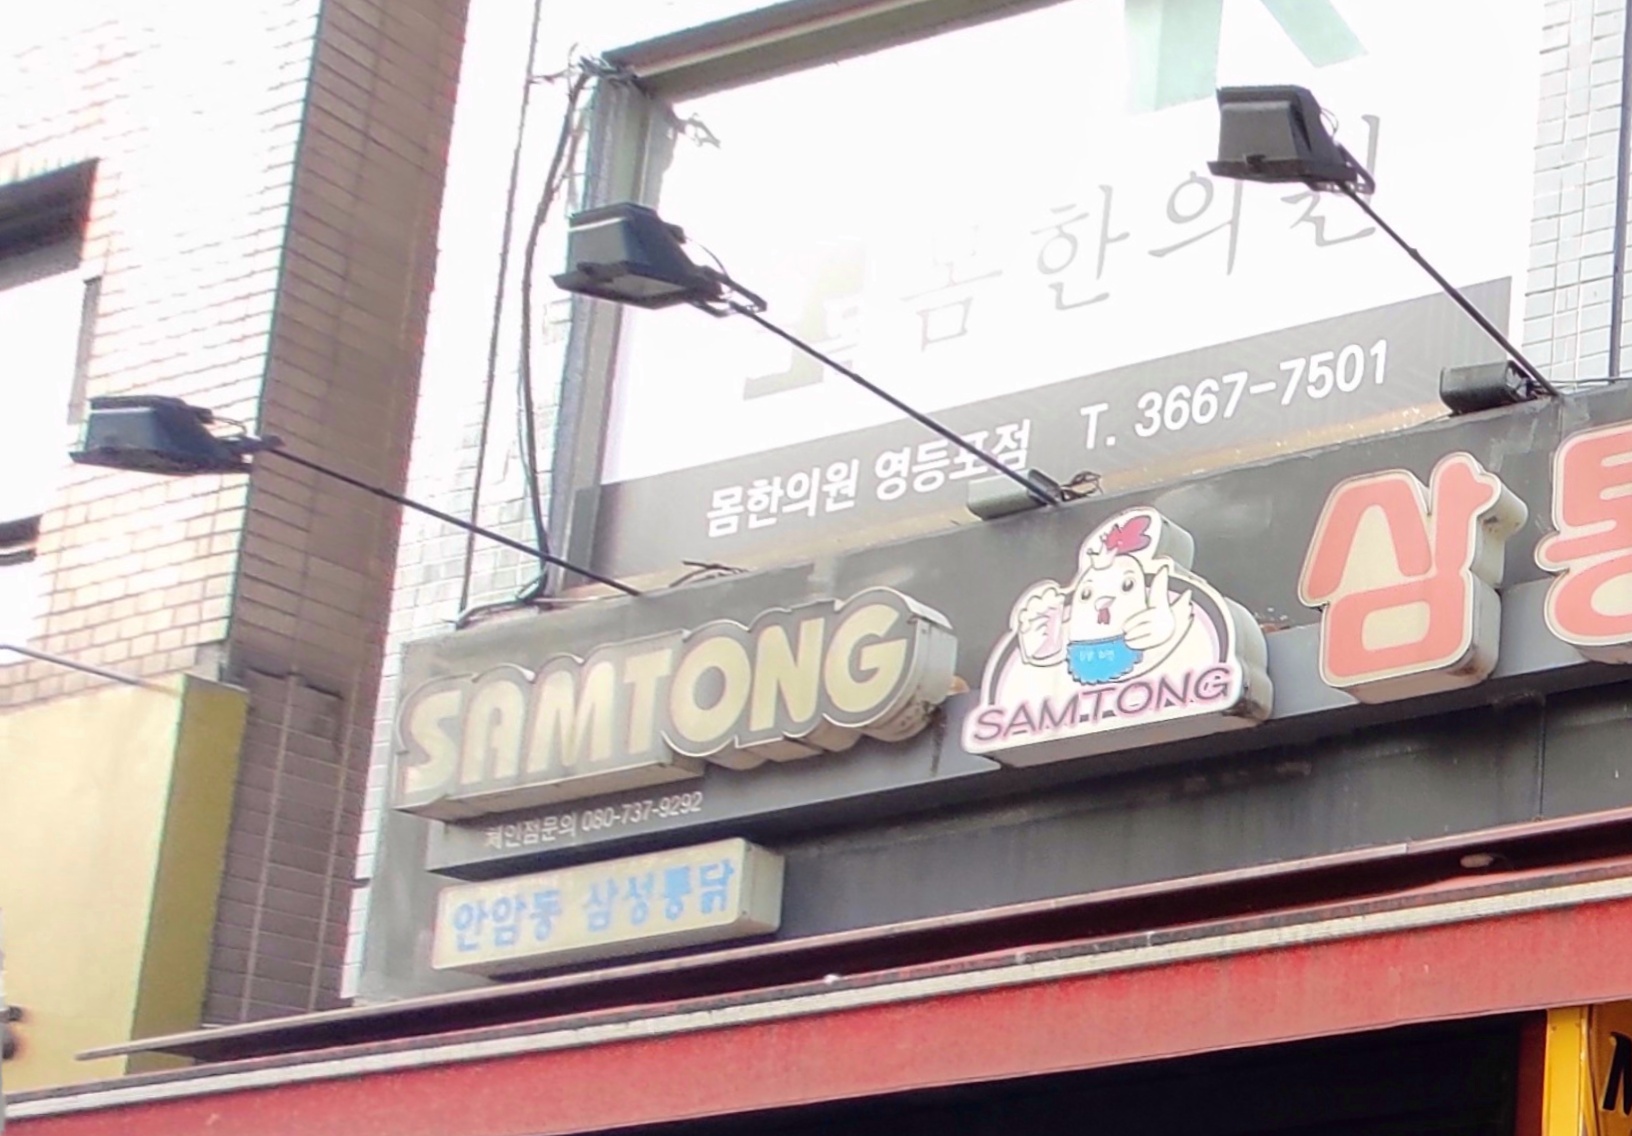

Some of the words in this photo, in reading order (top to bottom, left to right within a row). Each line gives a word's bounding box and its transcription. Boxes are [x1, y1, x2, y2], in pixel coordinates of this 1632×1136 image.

[1134, 340, 1390, 440] 3667-7501
[705, 458, 860, 538] 몸한의원
[873, 420, 1032, 504] 영등포점
[404, 601, 910, 796] SAMTONG
[974, 668, 1231, 742] SAMTONG
[581, 791, 704, 833] 080-737-9292
[453, 888, 563, 953] 안암동
